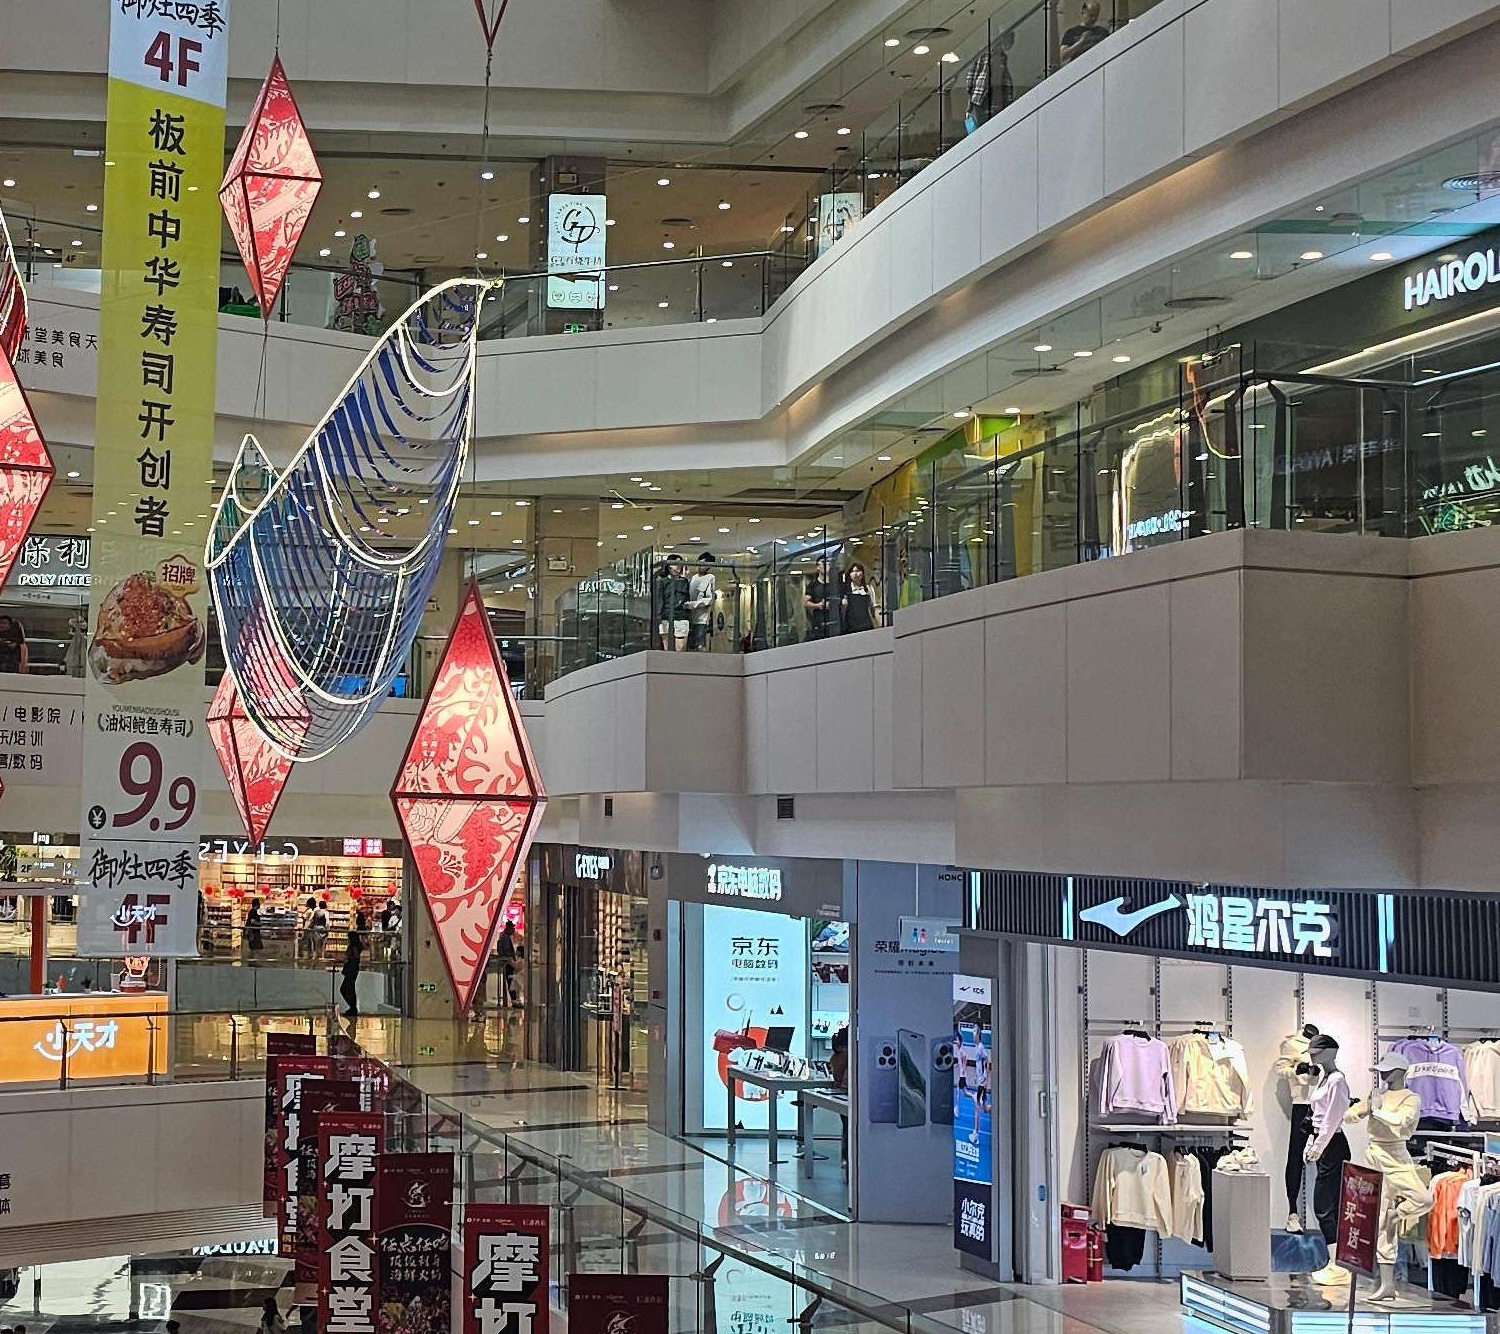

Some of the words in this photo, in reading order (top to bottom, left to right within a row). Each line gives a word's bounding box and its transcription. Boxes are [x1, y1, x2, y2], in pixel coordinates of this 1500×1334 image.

[144, 30, 202, 88] 4F
[65, 254, 77, 264] 4F
[134, 108, 188, 538] 板前中华寿司开创者
[19, 573, 54, 585] POLY
[162, 563, 196, 585] 招牌
[14, 705, 61, 725] 电影院
[112, 741, 197, 832] 9.9
[88, 847, 197, 891] 御灶四季
[1186, 893, 1332, 957] 鸿星尔克
[731, 937, 779, 956] 京东
[874, 940, 900, 953] 荣耀
[34, 1019, 118, 1060] 小天才
[323, 1133, 378, 1334] 摩打食堂
[381, 1233, 450, 1255] 任点任吃
